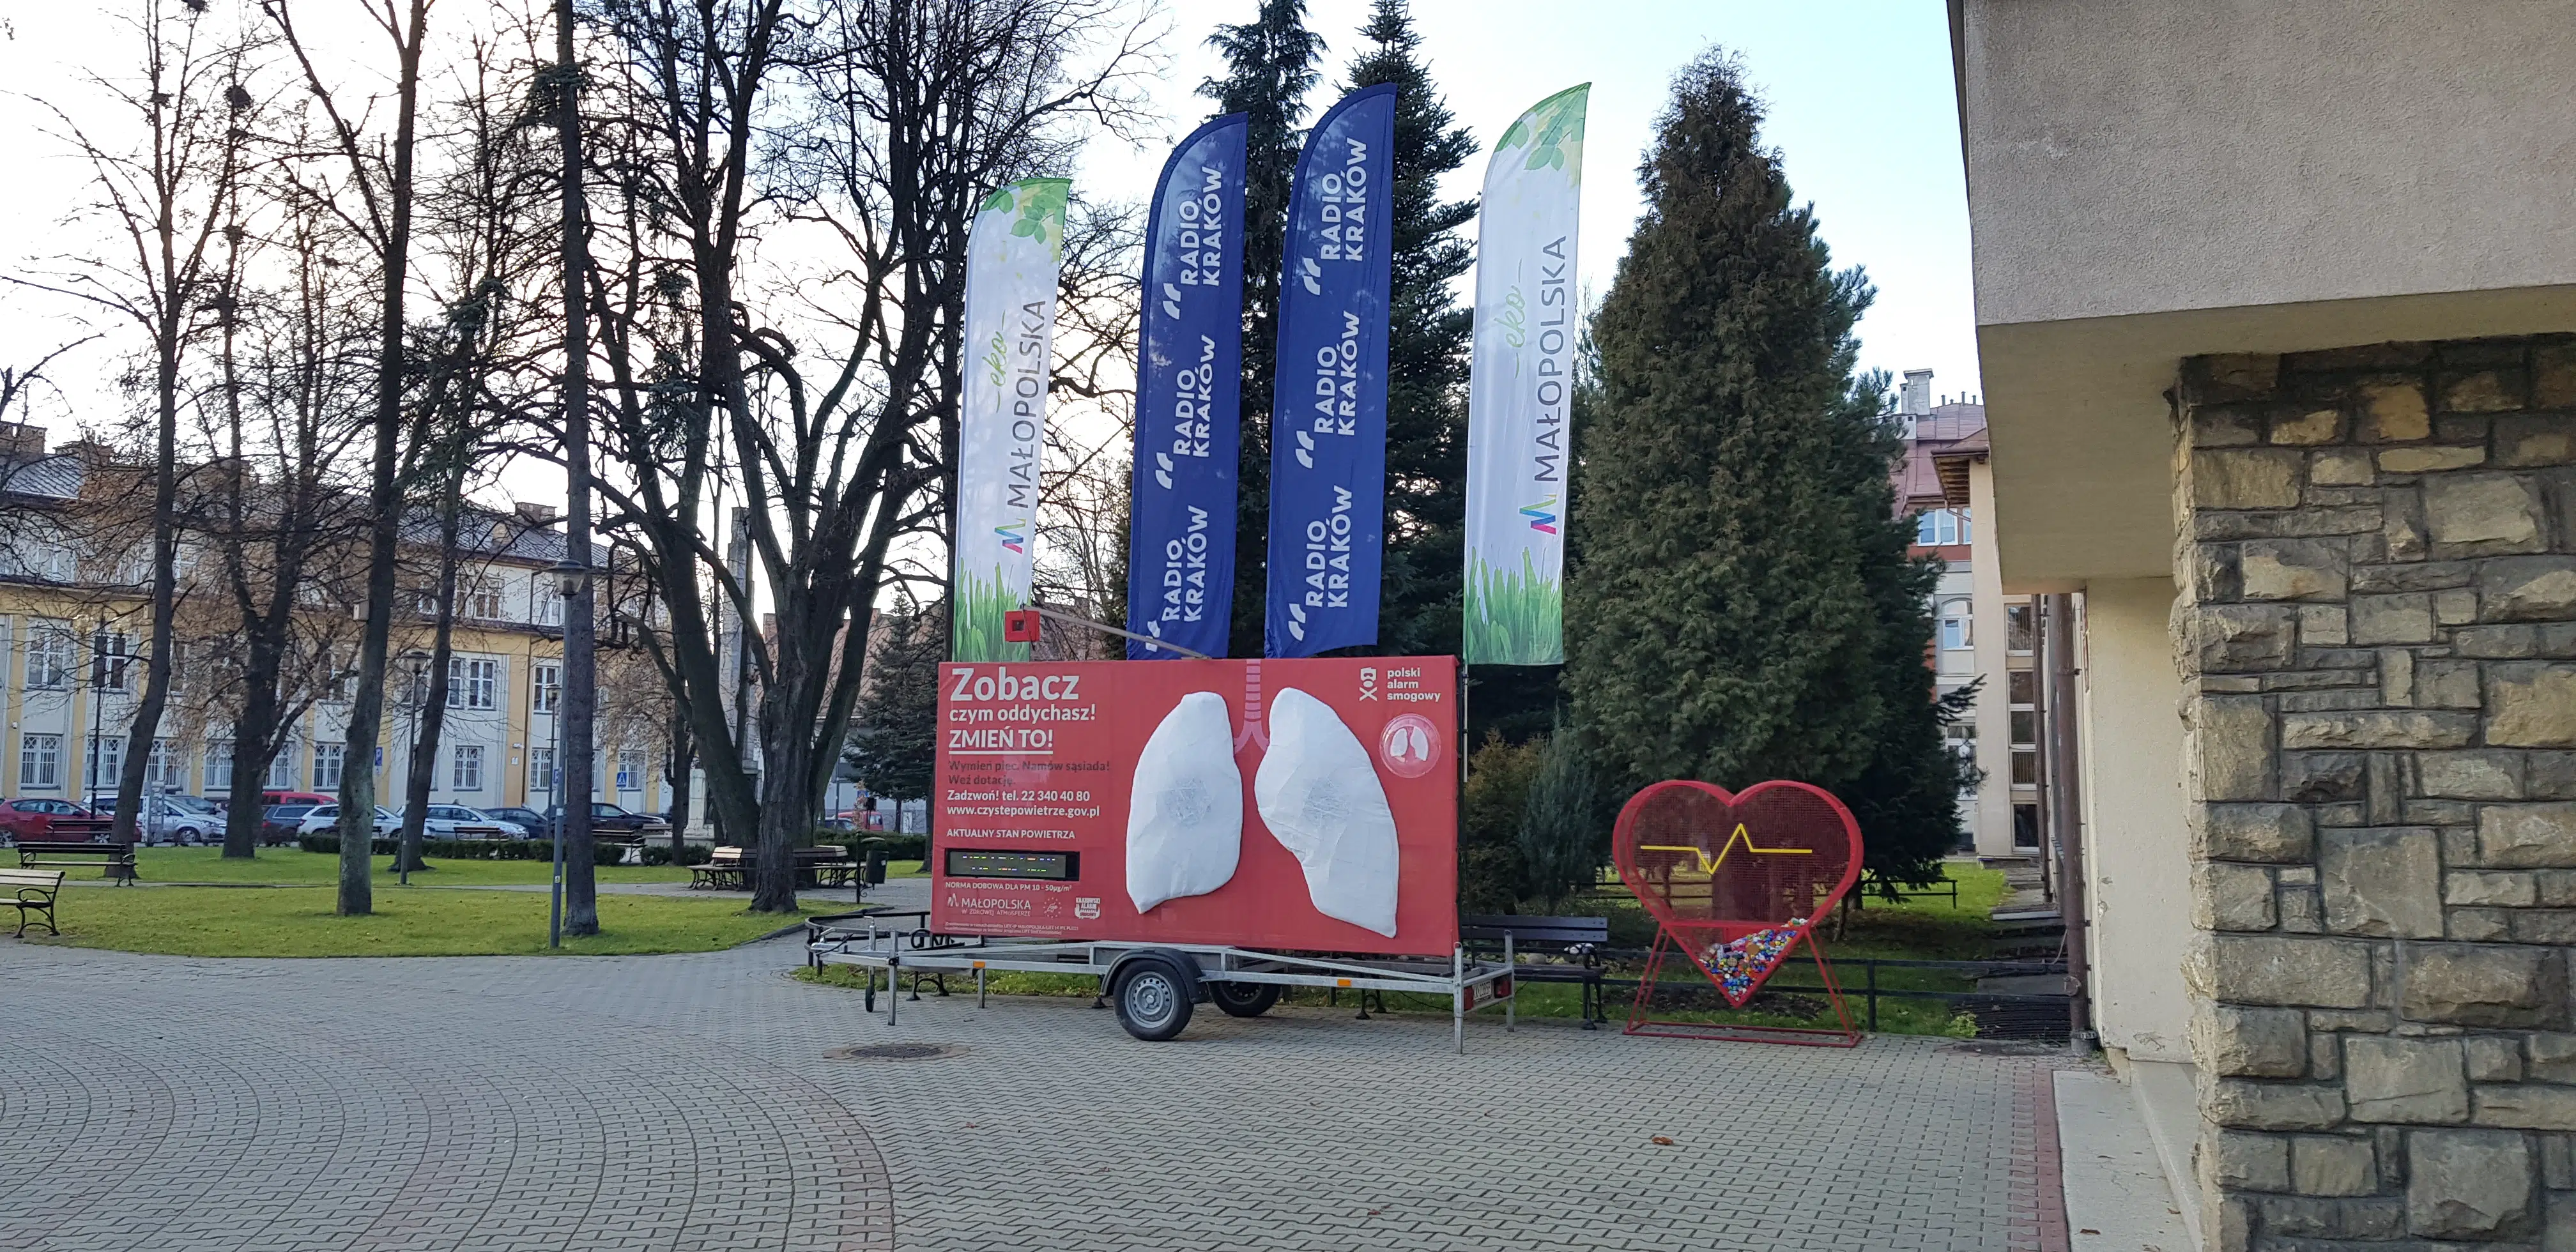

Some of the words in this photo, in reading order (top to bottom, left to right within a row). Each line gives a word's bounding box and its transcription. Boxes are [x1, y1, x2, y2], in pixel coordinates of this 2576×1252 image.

[1197, 166, 1222, 287] KRAKÓW
[1321, 173, 1342, 260] RADIO
[1341, 137, 1367, 262] KRAKÓW
[1179, 200, 1200, 286] RADIO
[1494, 285, 1526, 349] eko
[982, 331, 1009, 388] eko
[1314, 346, 1337, 434] RADIO
[1338, 311, 1360, 436] KRAKÓW
[1535, 236, 1567, 482] MAŁOPOLSKA
[1008, 300, 1046, 508] MAŁOPOLSKA
[1173, 369, 1196, 456] RADIO
[1192, 335, 1216, 457] KRAKÓW
[1161, 539, 1184, 622] RADIO
[1183, 505, 1209, 622] KRAKÓW
[1305, 521, 1326, 608] RADIO
[1327, 485, 1353, 609] KRAKÓW
[950, 666, 1080, 701] Zobacz
[1386, 692, 1441, 702] smogowy
[1387, 667, 1421, 679] polski
[1387, 679, 1419, 689] alarm
[949, 707, 993, 724] czym
[997, 703, 1096, 724] oddychasz!
[949, 726, 1013, 748] ZMIEŃ
[1018, 729, 1053, 747] TO!
[947, 790, 999, 801] Zadzwoń!
[1002, 790, 1018, 801] tel.
[1022, 791, 1035, 801] 22
[1037, 791, 1057, 801] 340
[1059, 791, 1074, 801] 40
[1076, 791, 1090, 802] 80
[948, 775, 971, 785] Weź
[974, 775, 1016, 787] dotację.
[949, 761, 992, 773] Wymień
[995, 761, 1020, 773] piec.
[1022, 761, 1063, 772] Namów
[1066, 761, 1110, 774] sąsiada!
[947, 805, 1100, 818] www.czystepowietrze.gov.pl
[947, 829, 994, 838] AKTUALNY
[996, 830, 1020, 838] STAN
[1022, 830, 1075, 839] POWIETRZA
[962, 898, 1031, 910] MAŁOPOLSKA
